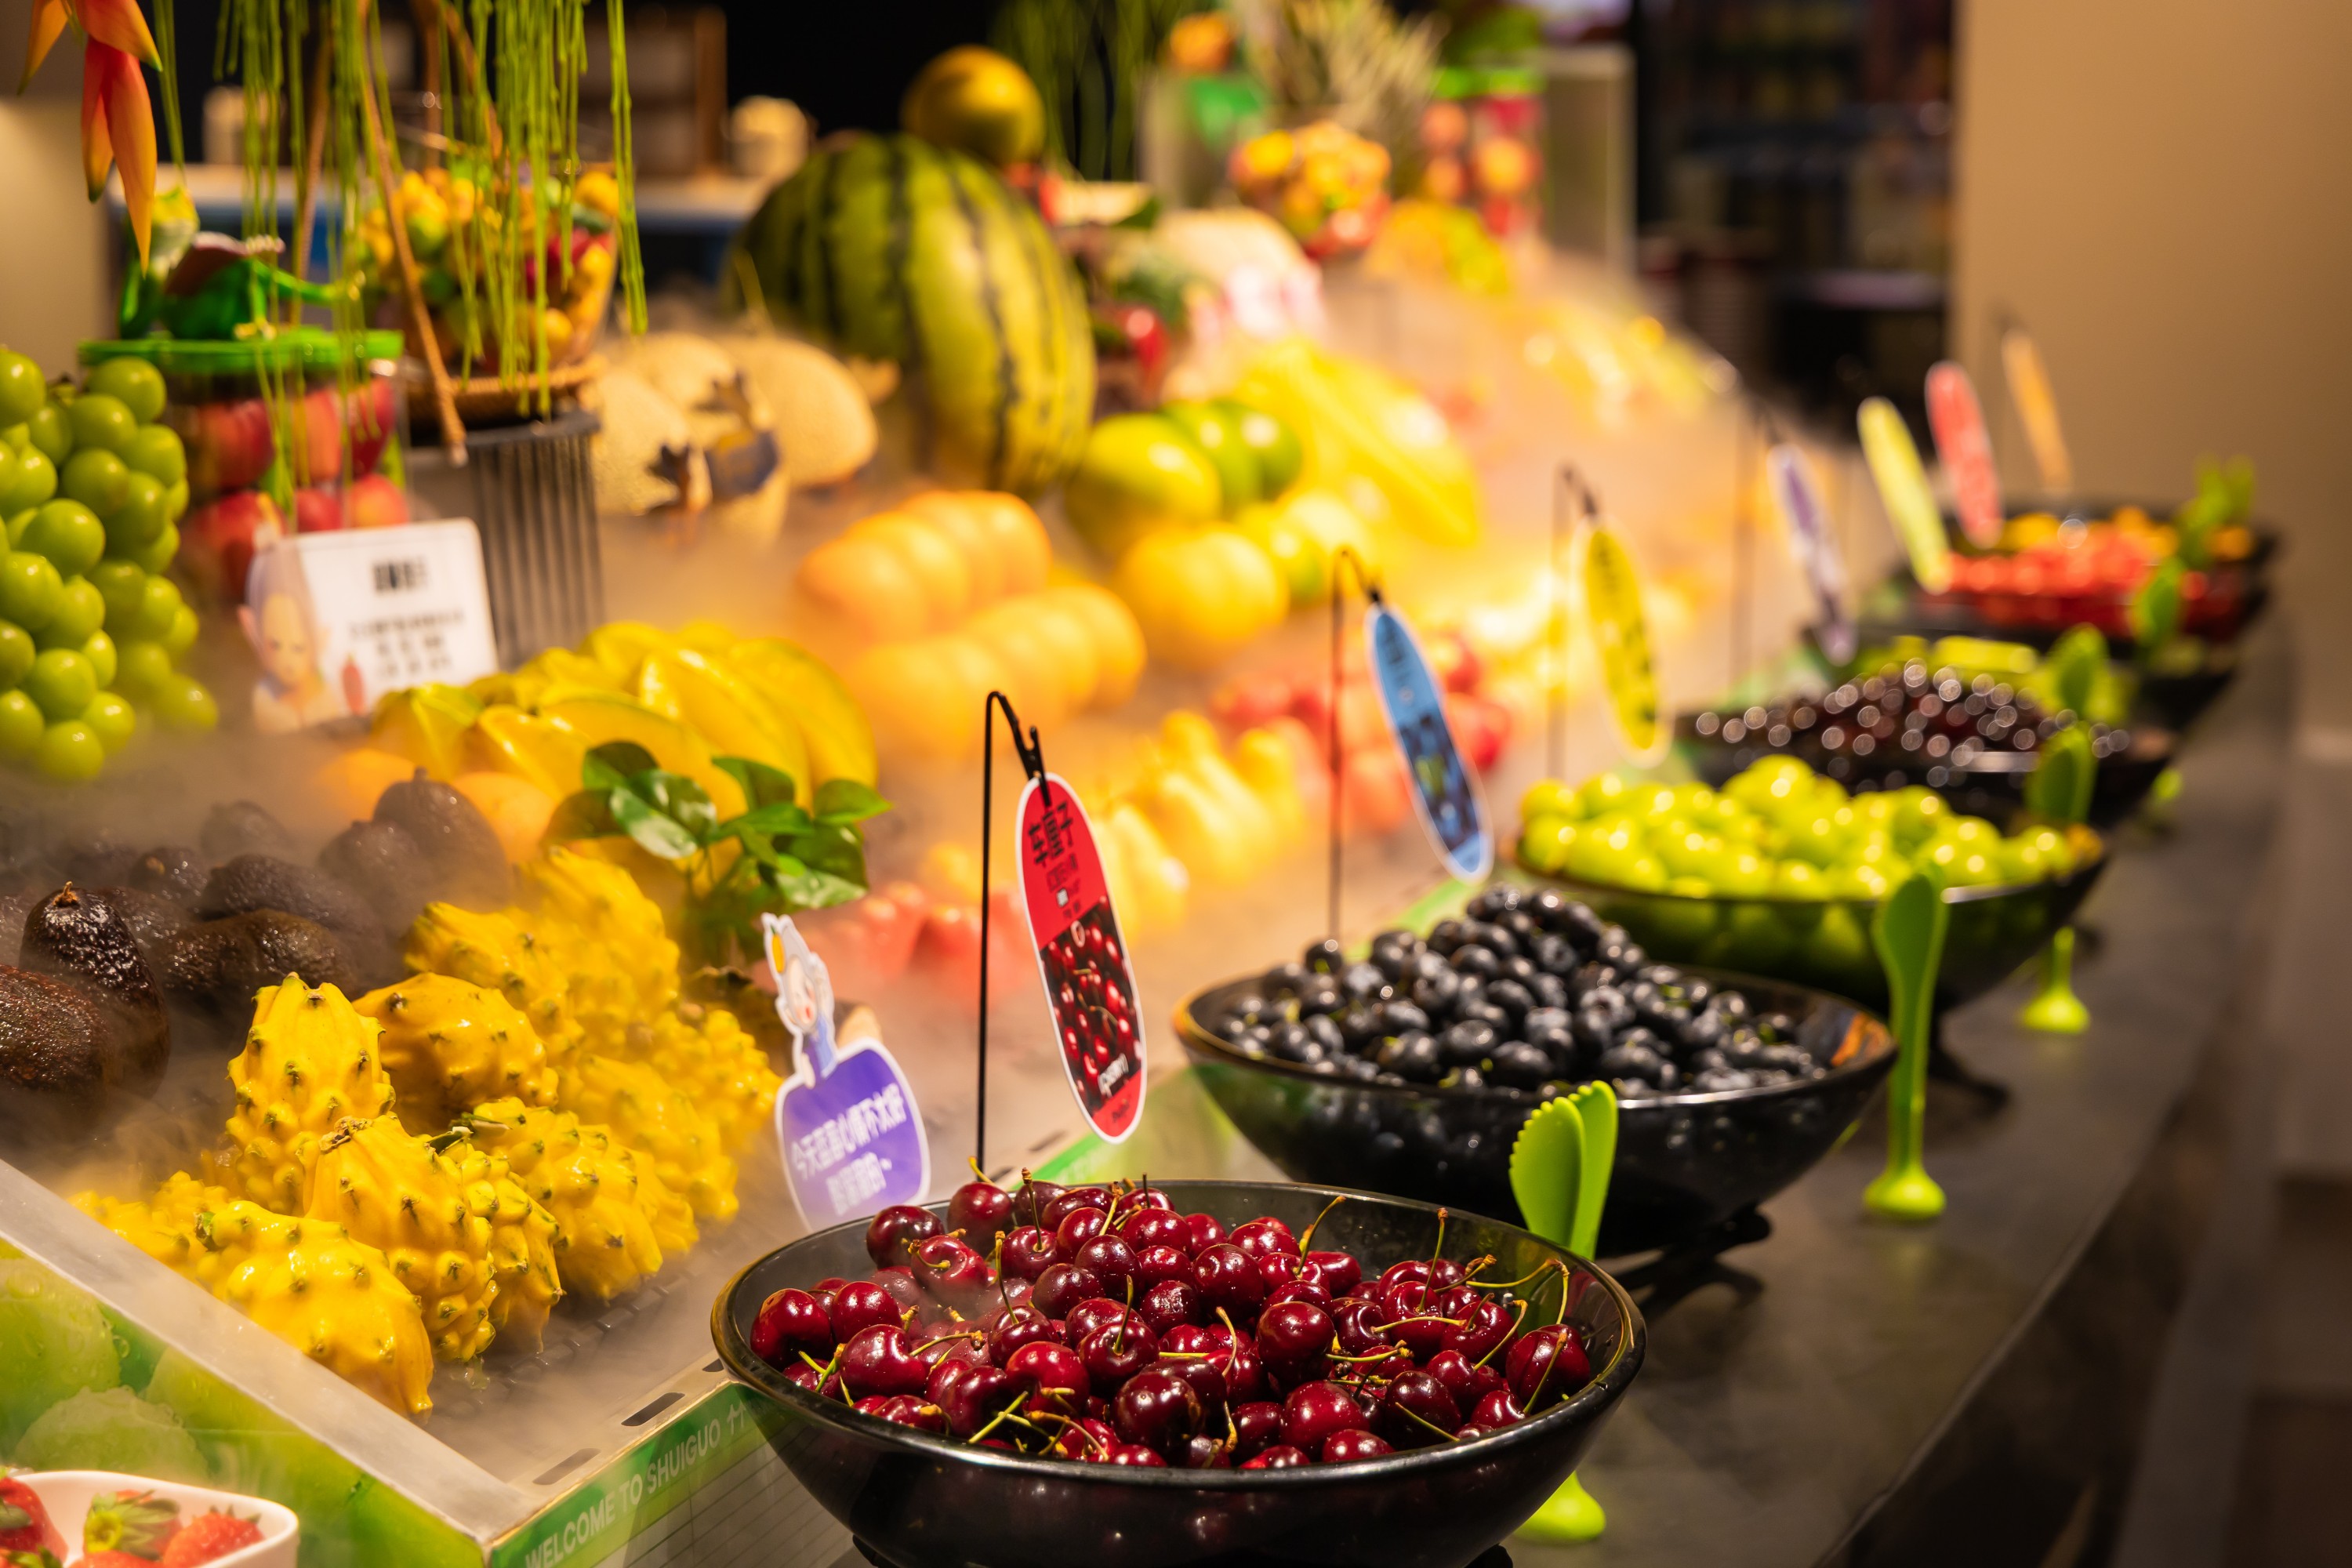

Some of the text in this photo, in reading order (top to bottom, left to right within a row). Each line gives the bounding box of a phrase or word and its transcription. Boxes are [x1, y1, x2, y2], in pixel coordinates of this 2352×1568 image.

[525, 1491, 615, 1568] WELCOME
[619, 1473, 643, 1512] TO
[646, 1418, 721, 1494] SHUIGUO
